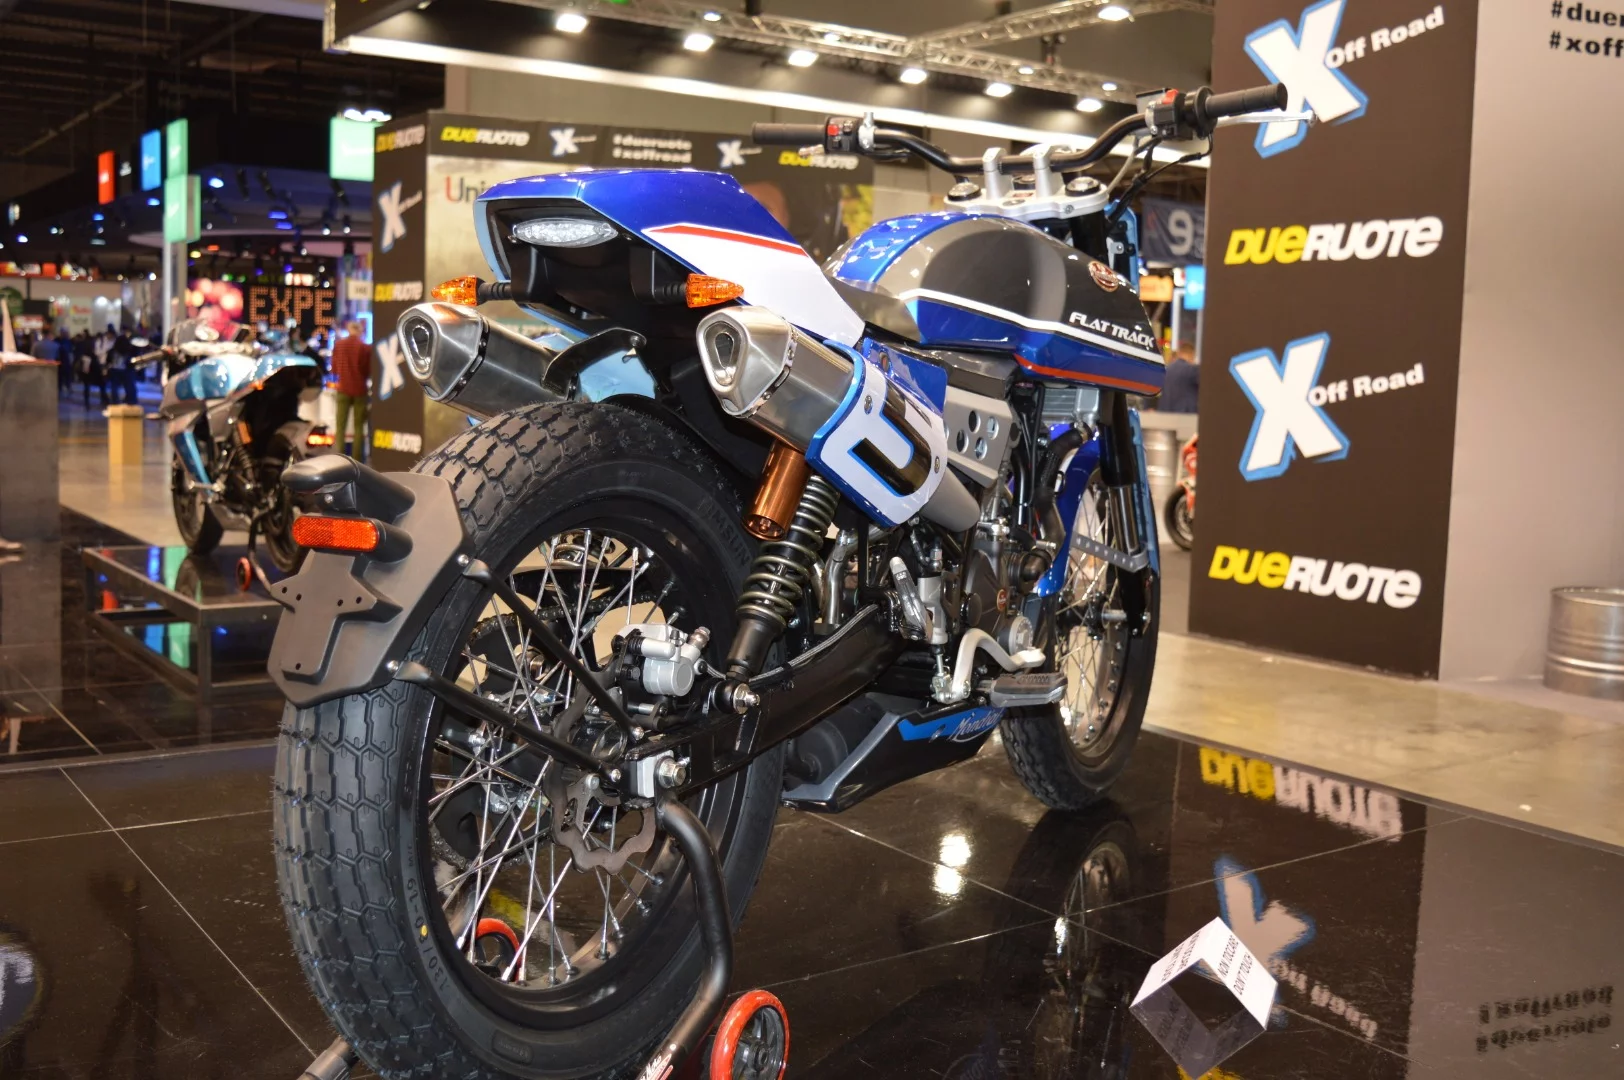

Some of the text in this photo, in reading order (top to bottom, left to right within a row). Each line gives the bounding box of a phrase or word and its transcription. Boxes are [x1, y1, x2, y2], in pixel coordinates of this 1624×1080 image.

[1325, 36, 1367, 69] Off
[1371, 5, 1445, 51] Road
[249, 287, 335, 325] EXPE
[1069, 312, 1155, 349] FLAT TRACK
[1229, 332, 1425, 481] X Off Road
